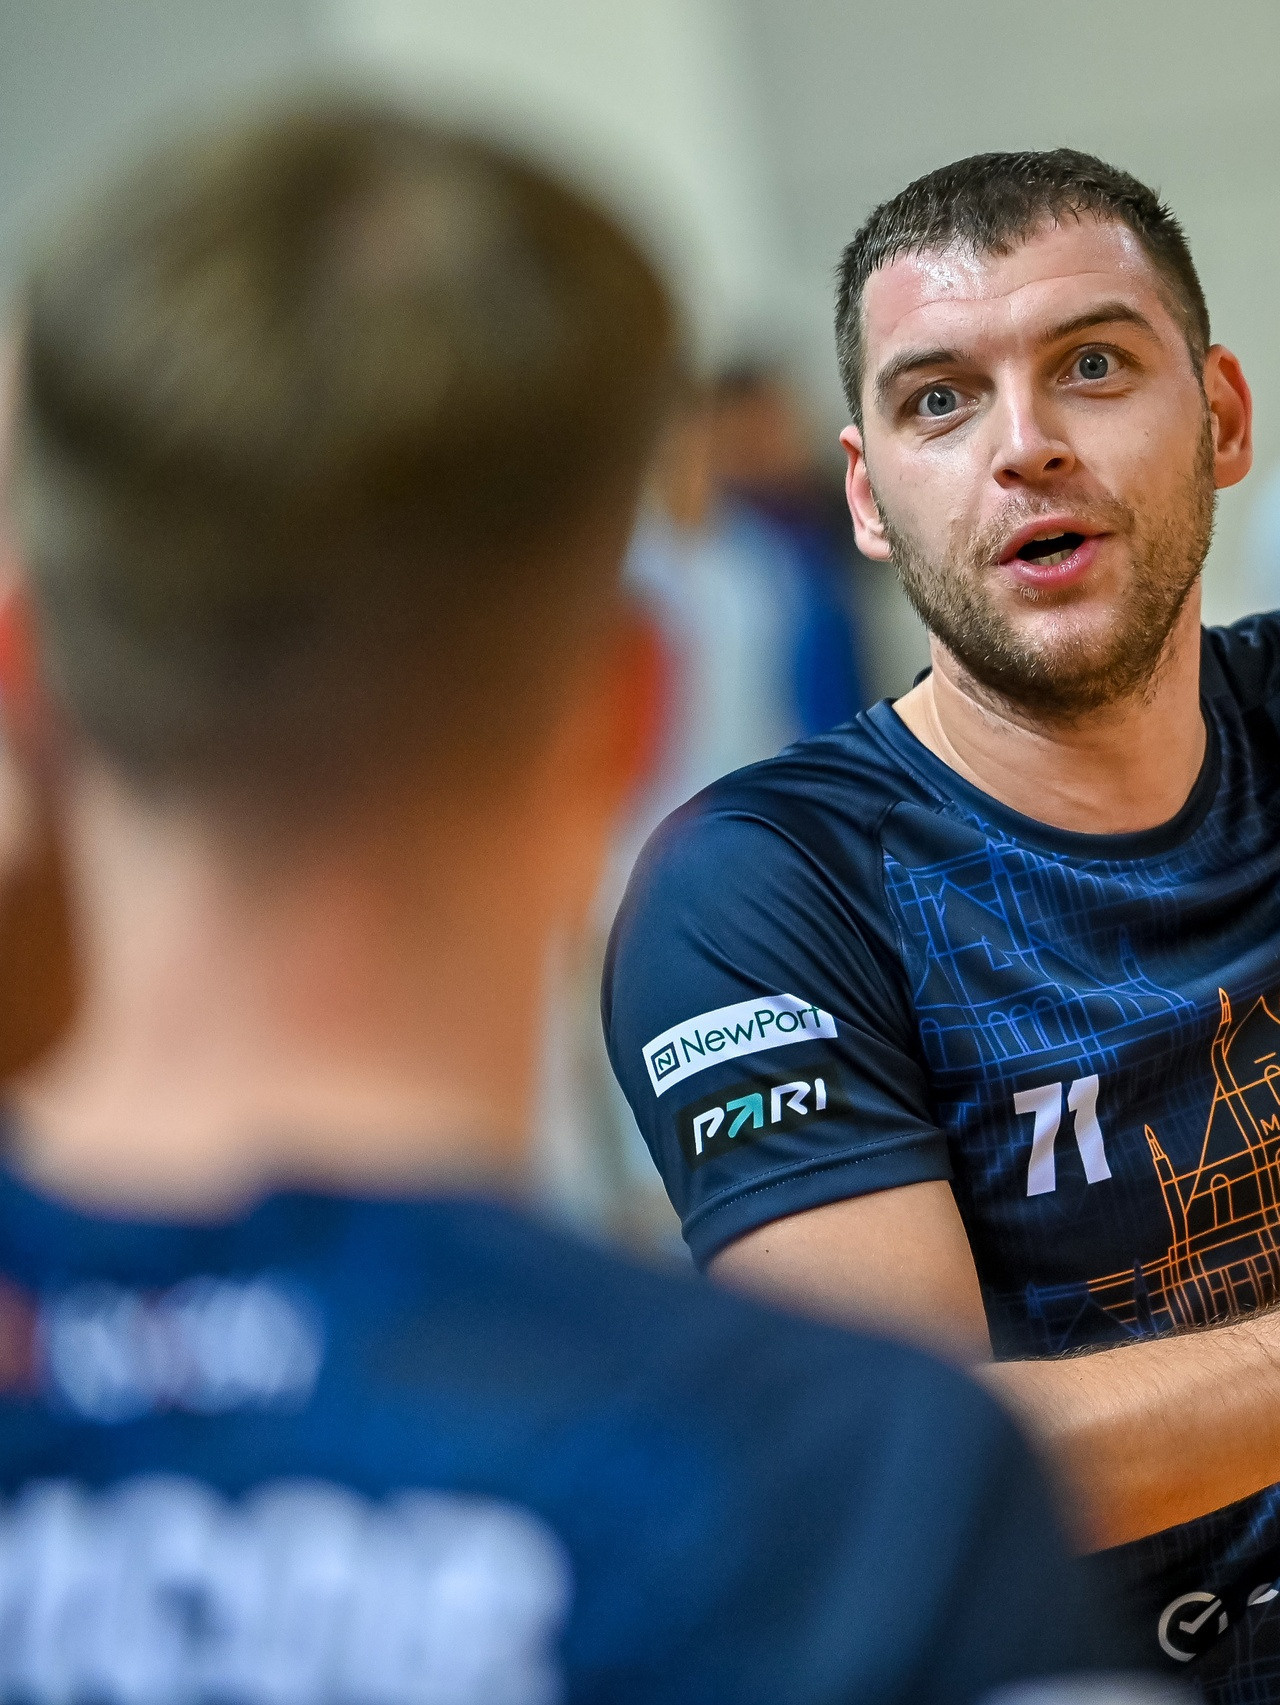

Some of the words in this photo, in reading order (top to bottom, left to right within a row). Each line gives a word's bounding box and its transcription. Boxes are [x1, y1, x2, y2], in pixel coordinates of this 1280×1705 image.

[680, 1005, 821, 1063] NewPort
[693, 1078, 827, 1156] PARI
[1013, 1073, 1112, 1197] 71
